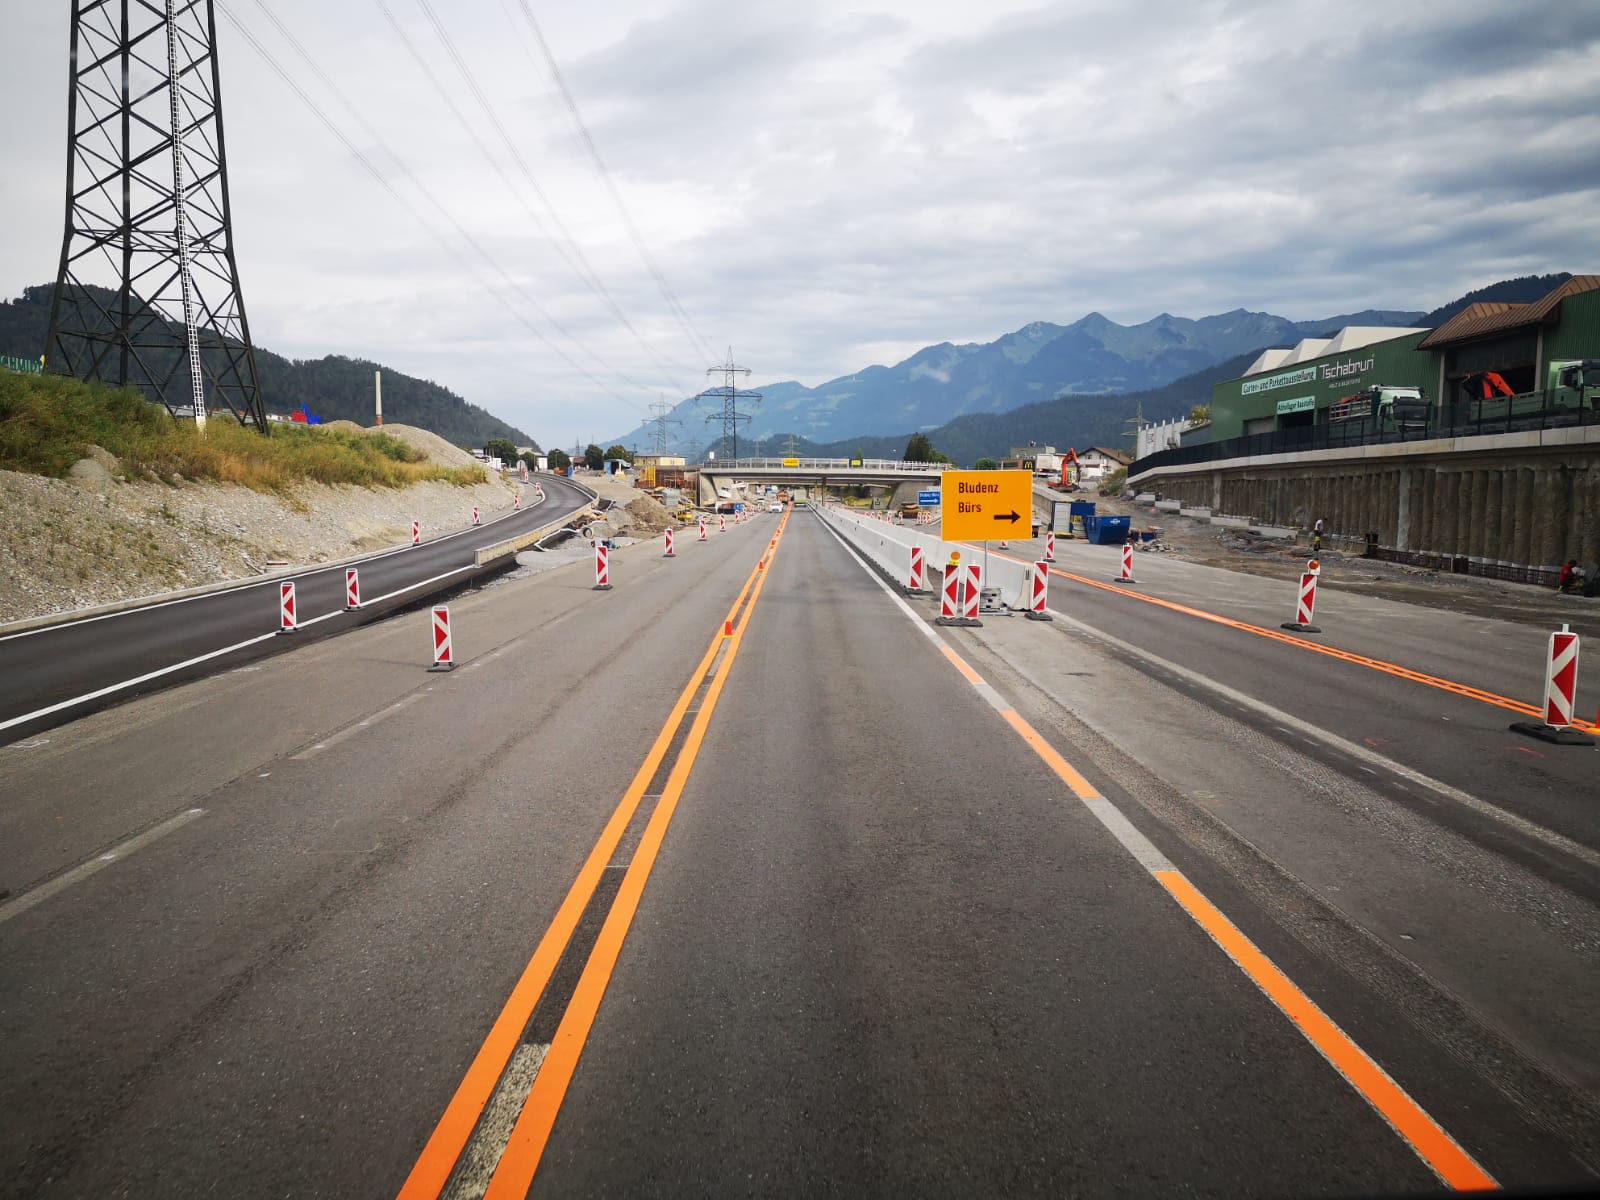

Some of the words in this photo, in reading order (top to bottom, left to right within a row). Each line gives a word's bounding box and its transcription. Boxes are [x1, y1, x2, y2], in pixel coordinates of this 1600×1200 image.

[1319, 358, 1375, 379] Tschabrun
[958, 481, 999, 494] Bludenz
[958, 501, 982, 513] Bürs
